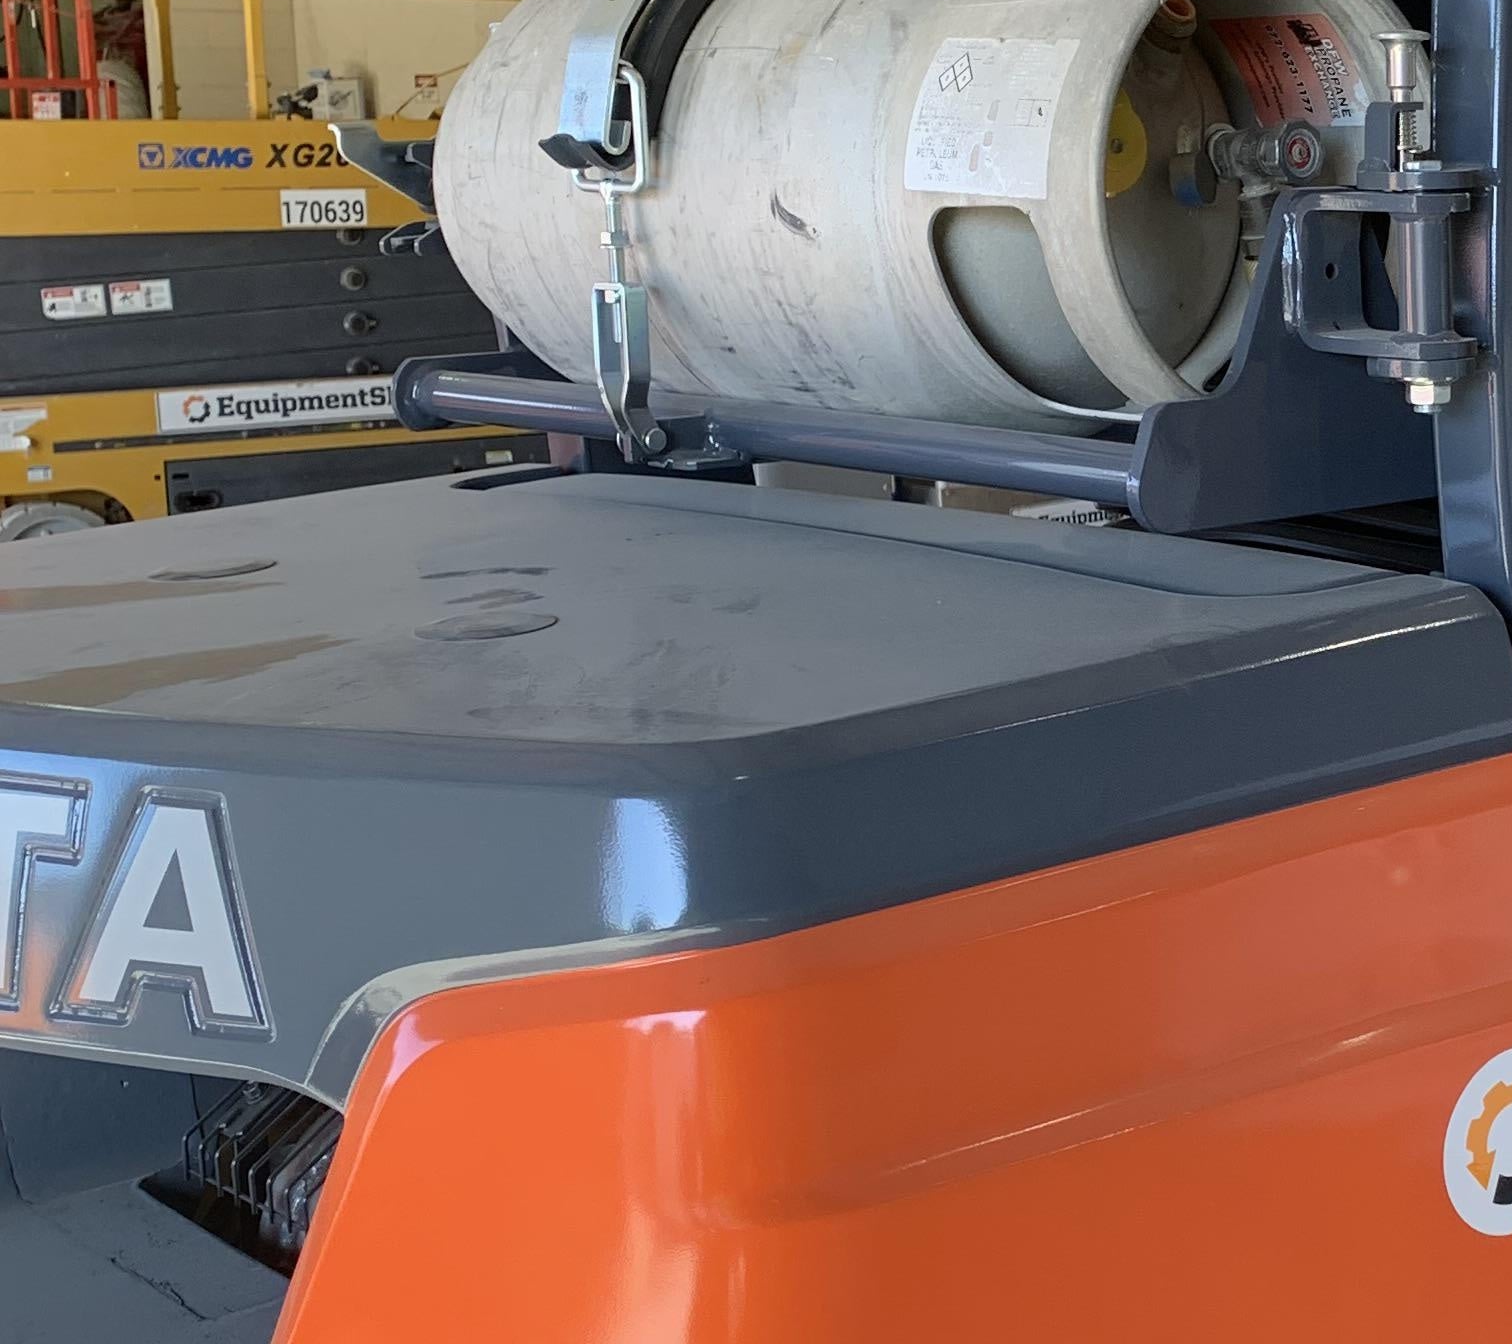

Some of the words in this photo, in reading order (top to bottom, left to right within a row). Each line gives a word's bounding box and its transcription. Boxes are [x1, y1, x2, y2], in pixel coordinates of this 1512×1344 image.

[1320, 37, 1349, 76] DFW
[1316, 47, 1351, 118] PROPANE
[169, 147, 253, 169] XCMG
[282, 200, 364, 223] 170639
[216, 386, 391, 421] EquipmentS
